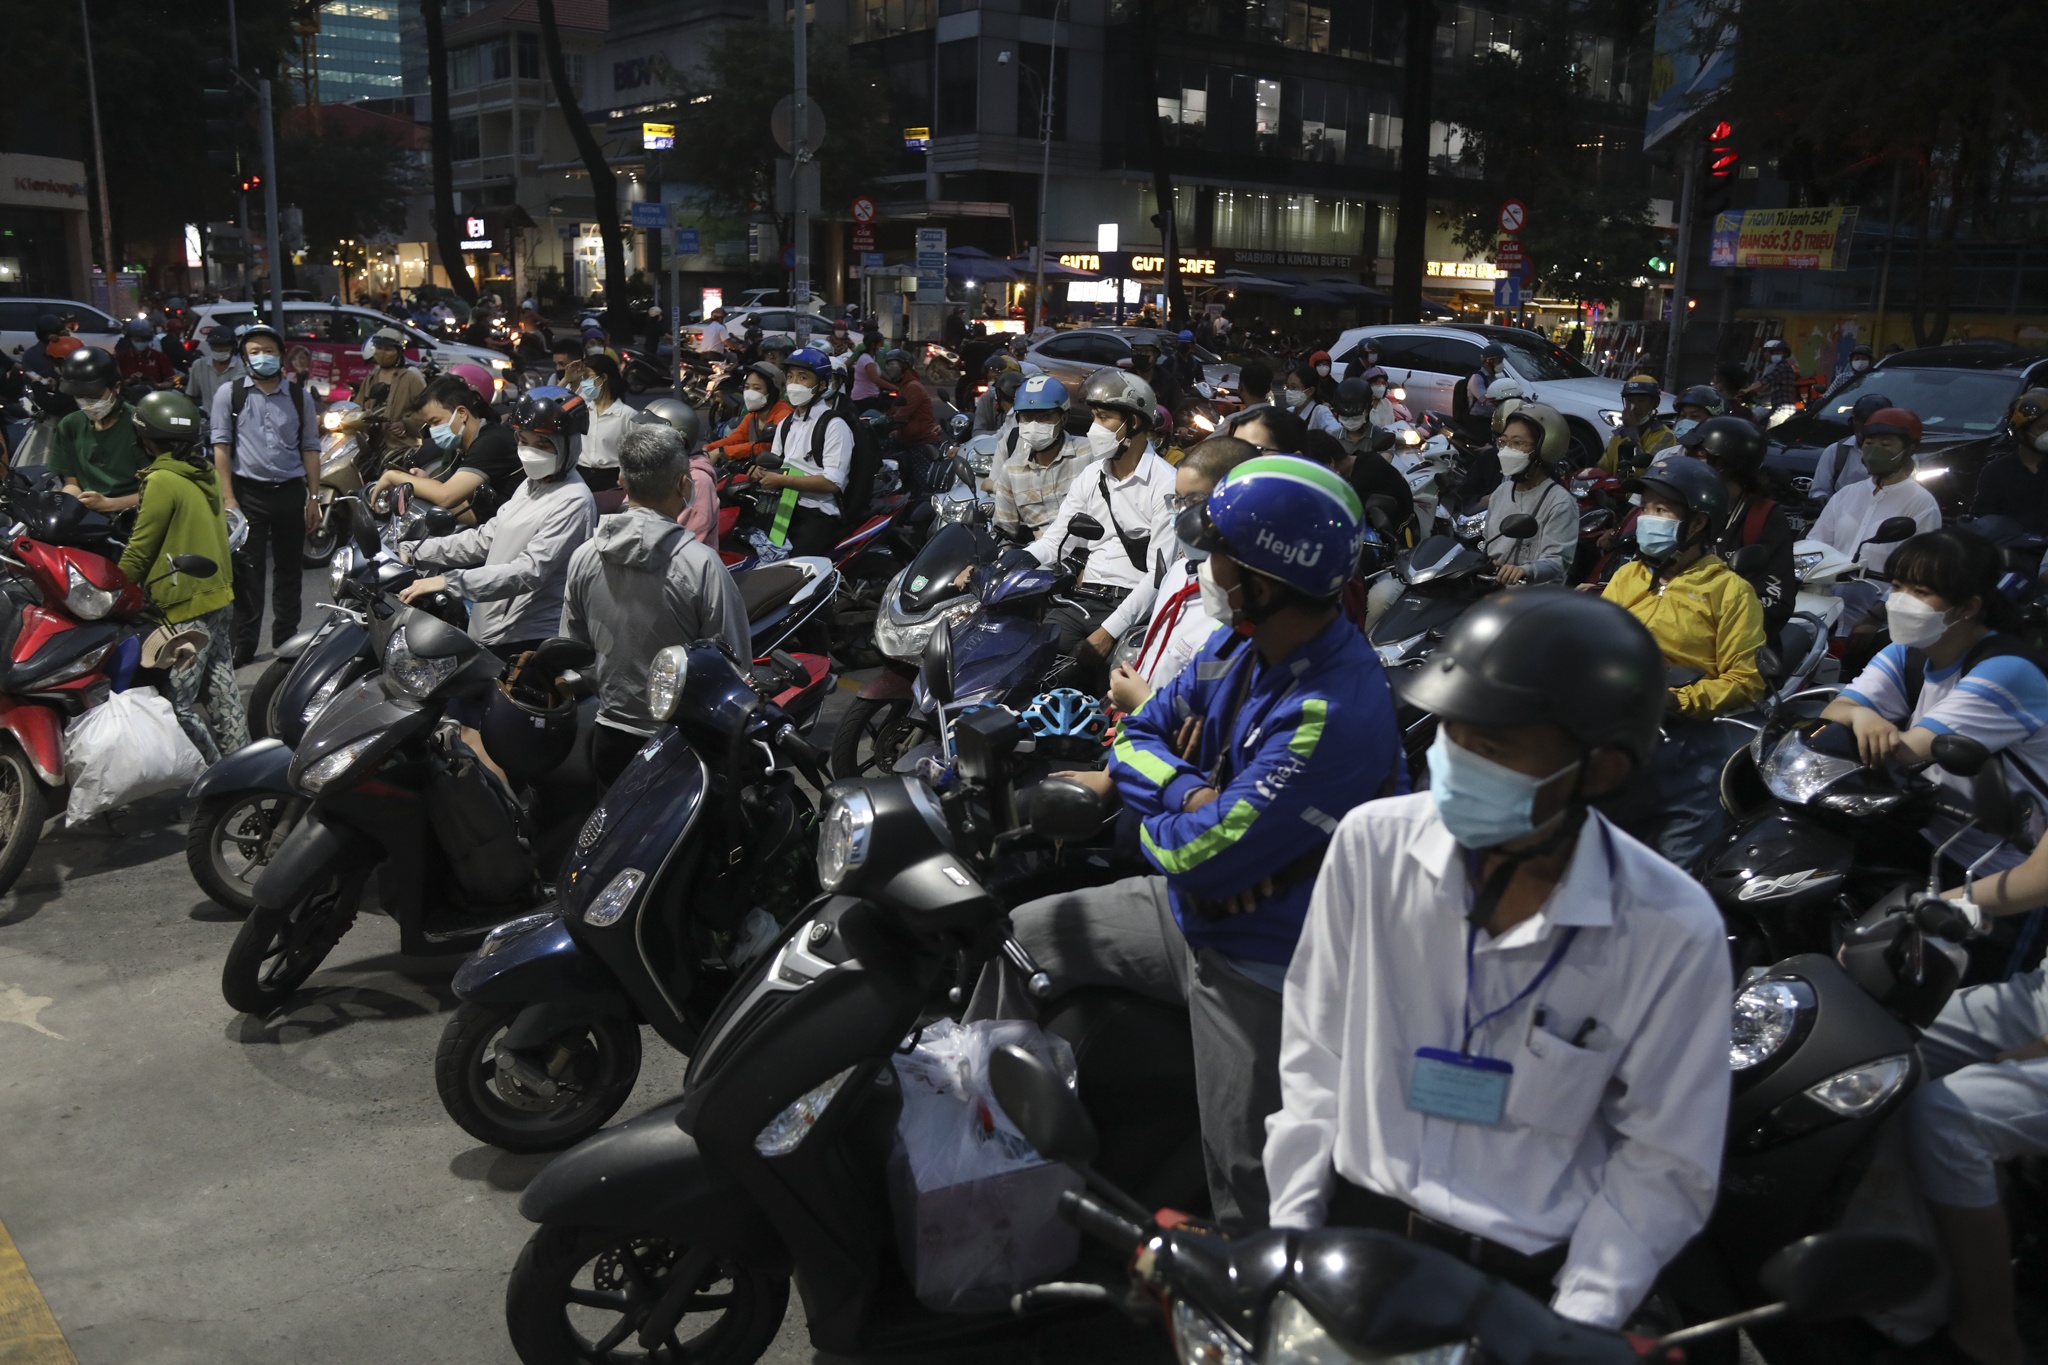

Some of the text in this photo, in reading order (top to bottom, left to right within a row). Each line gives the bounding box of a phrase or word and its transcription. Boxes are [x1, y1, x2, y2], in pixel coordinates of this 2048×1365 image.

[1776, 209, 1787, 226] Tủ
[1788, 211, 1810, 229] lạnh
[1503, 242, 1518, 251] CẤM
[1761, 229, 1780, 249] SỐC
[1059, 255, 1100, 270] GUTA
[1131, 256, 1166, 272] GUT
[1234, 250, 1352, 268] SHABURI & KINTAN BUFFET
